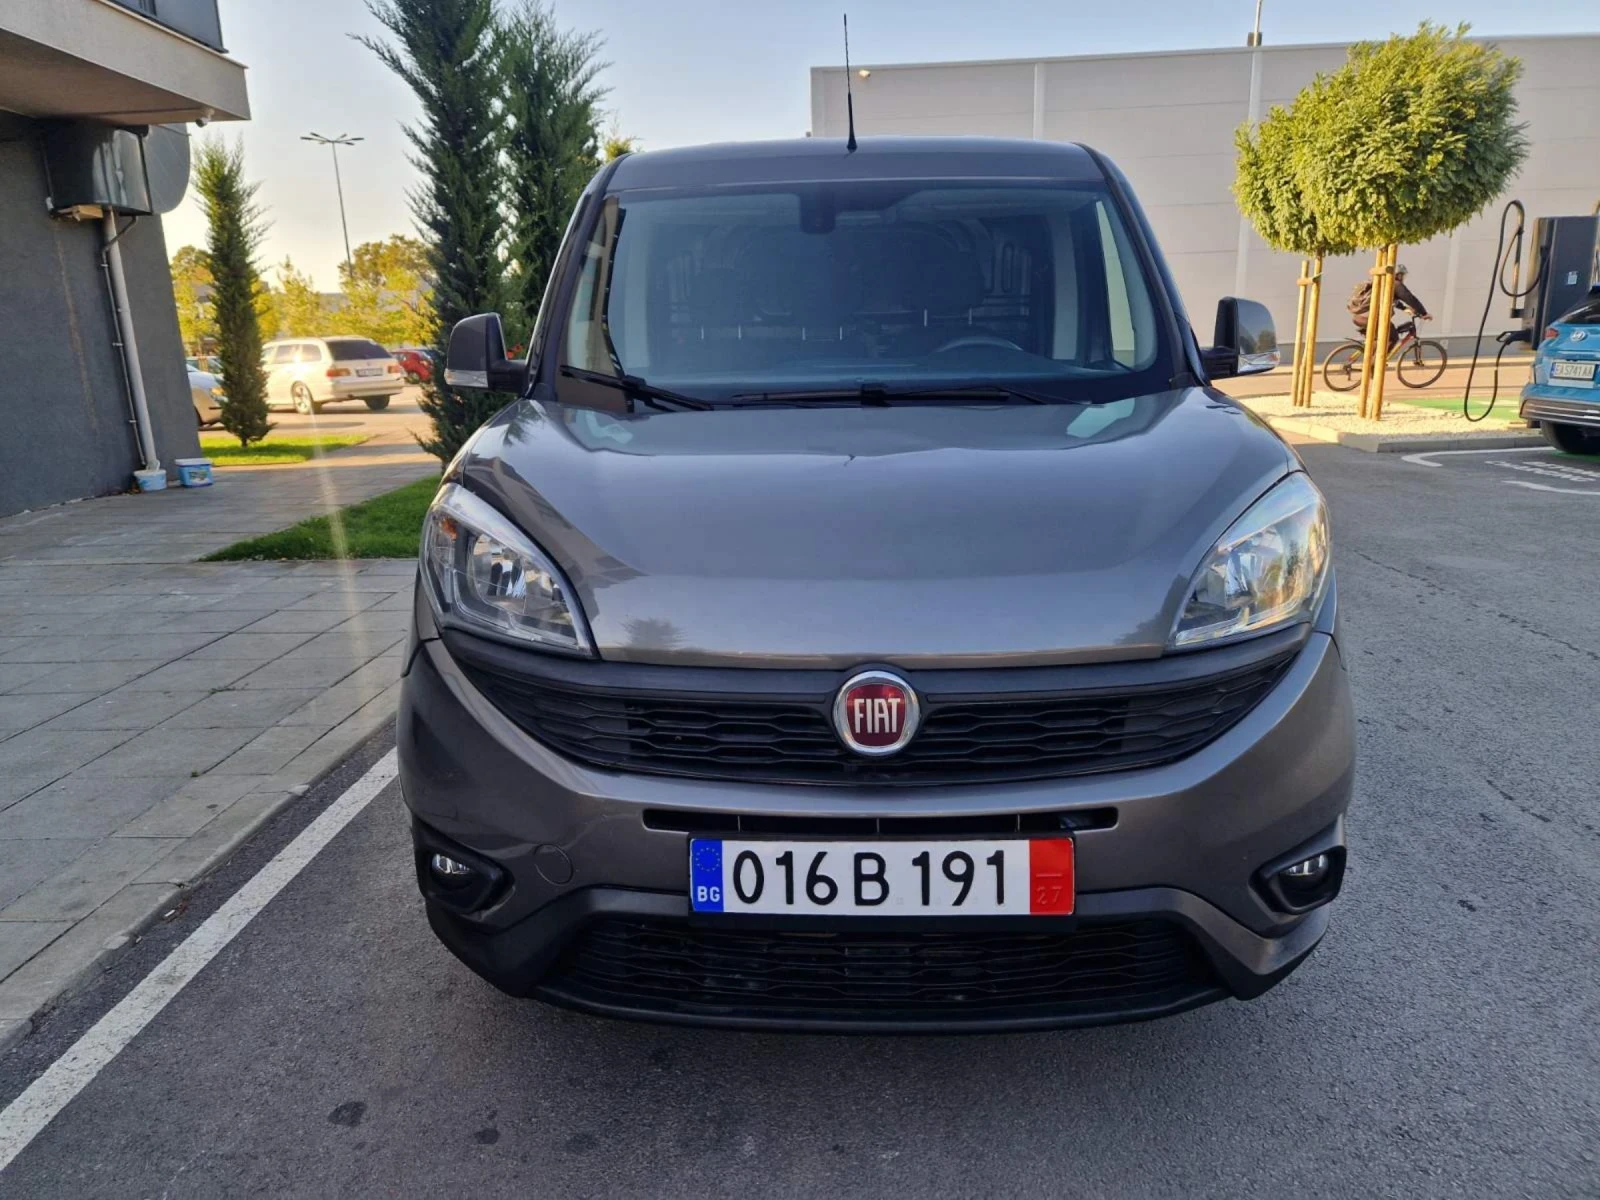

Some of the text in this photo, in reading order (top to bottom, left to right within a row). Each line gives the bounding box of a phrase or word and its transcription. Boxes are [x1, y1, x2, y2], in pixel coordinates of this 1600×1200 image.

[854, 698, 900, 733] FIAT
[697, 885, 721, 903] BG
[732, 849, 1005, 907] 016 B 191
